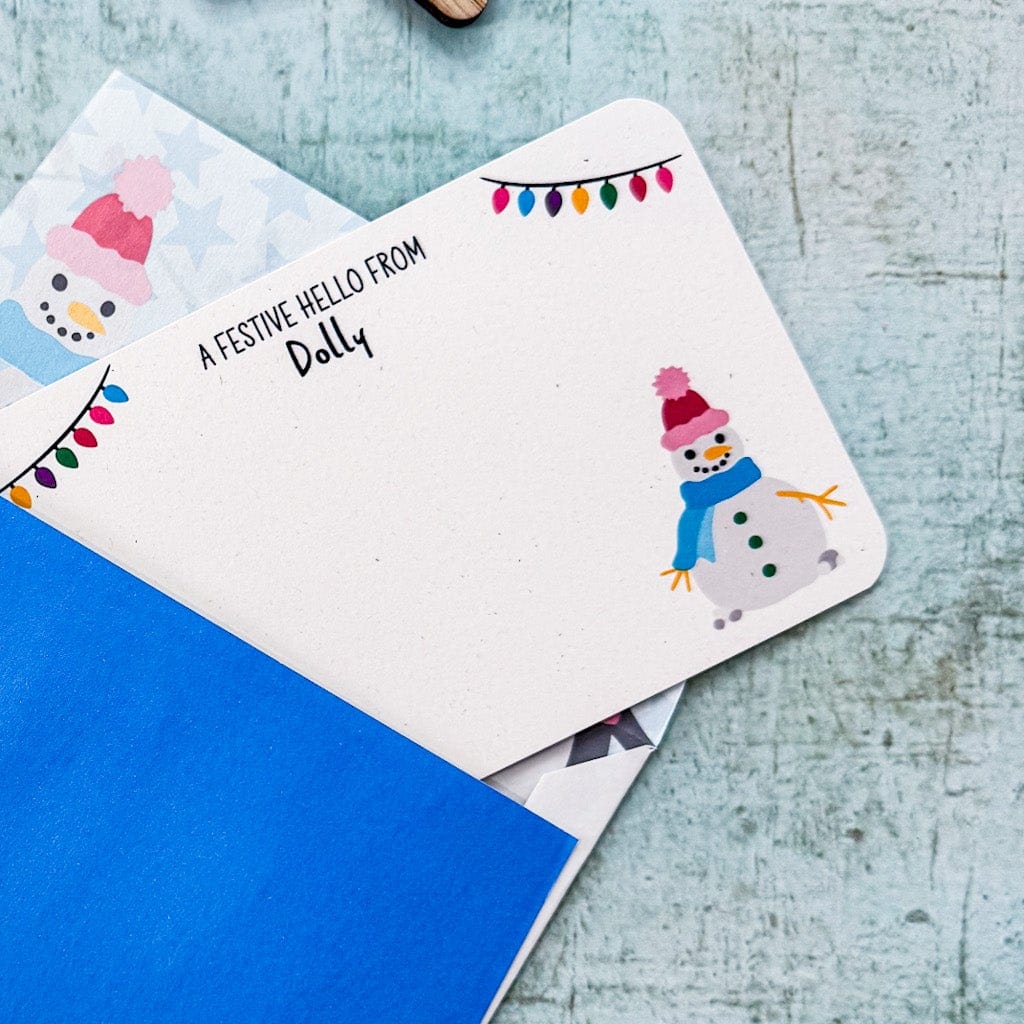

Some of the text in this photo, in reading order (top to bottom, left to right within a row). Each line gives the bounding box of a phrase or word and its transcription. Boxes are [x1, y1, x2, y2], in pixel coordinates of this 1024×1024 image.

[199, 235, 427, 370] A FESTIVE HELLO FROM
[285, 315, 374, 378] Dolly
